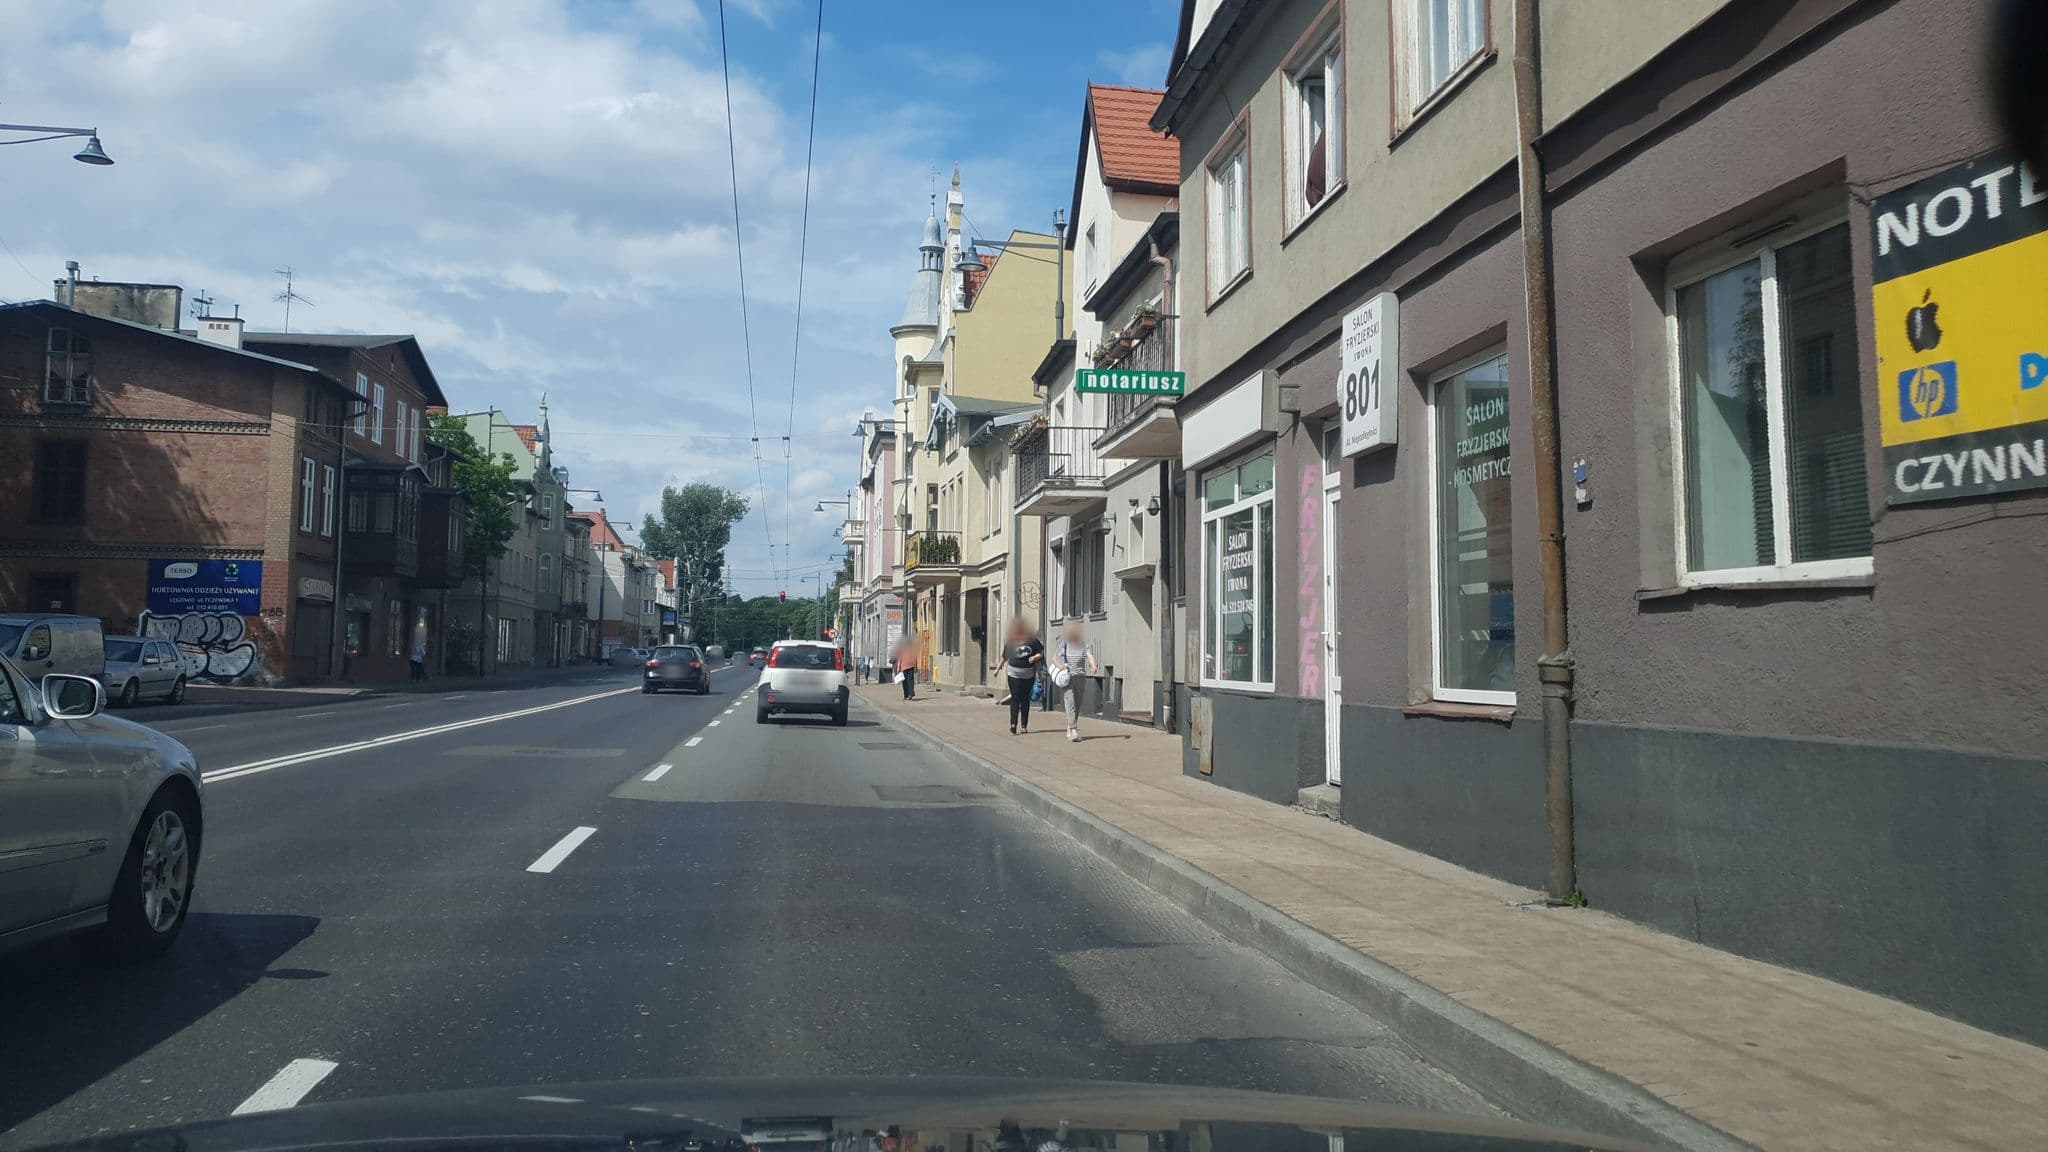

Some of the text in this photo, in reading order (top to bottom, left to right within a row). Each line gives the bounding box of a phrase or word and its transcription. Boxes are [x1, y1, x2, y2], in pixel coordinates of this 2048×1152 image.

[1353, 308, 1373, 330] SALON
[1087, 373, 1180, 390] notariusz
[1346, 358, 1380, 422] 801
[1466, 395, 1504, 426] SALON
[1895, 439, 2047, 493] CZYNN
[1228, 532, 1248, 550] SALON
[151, 586, 194, 594] HURTOWNIA
[1228, 576, 1248, 592] IWONA
